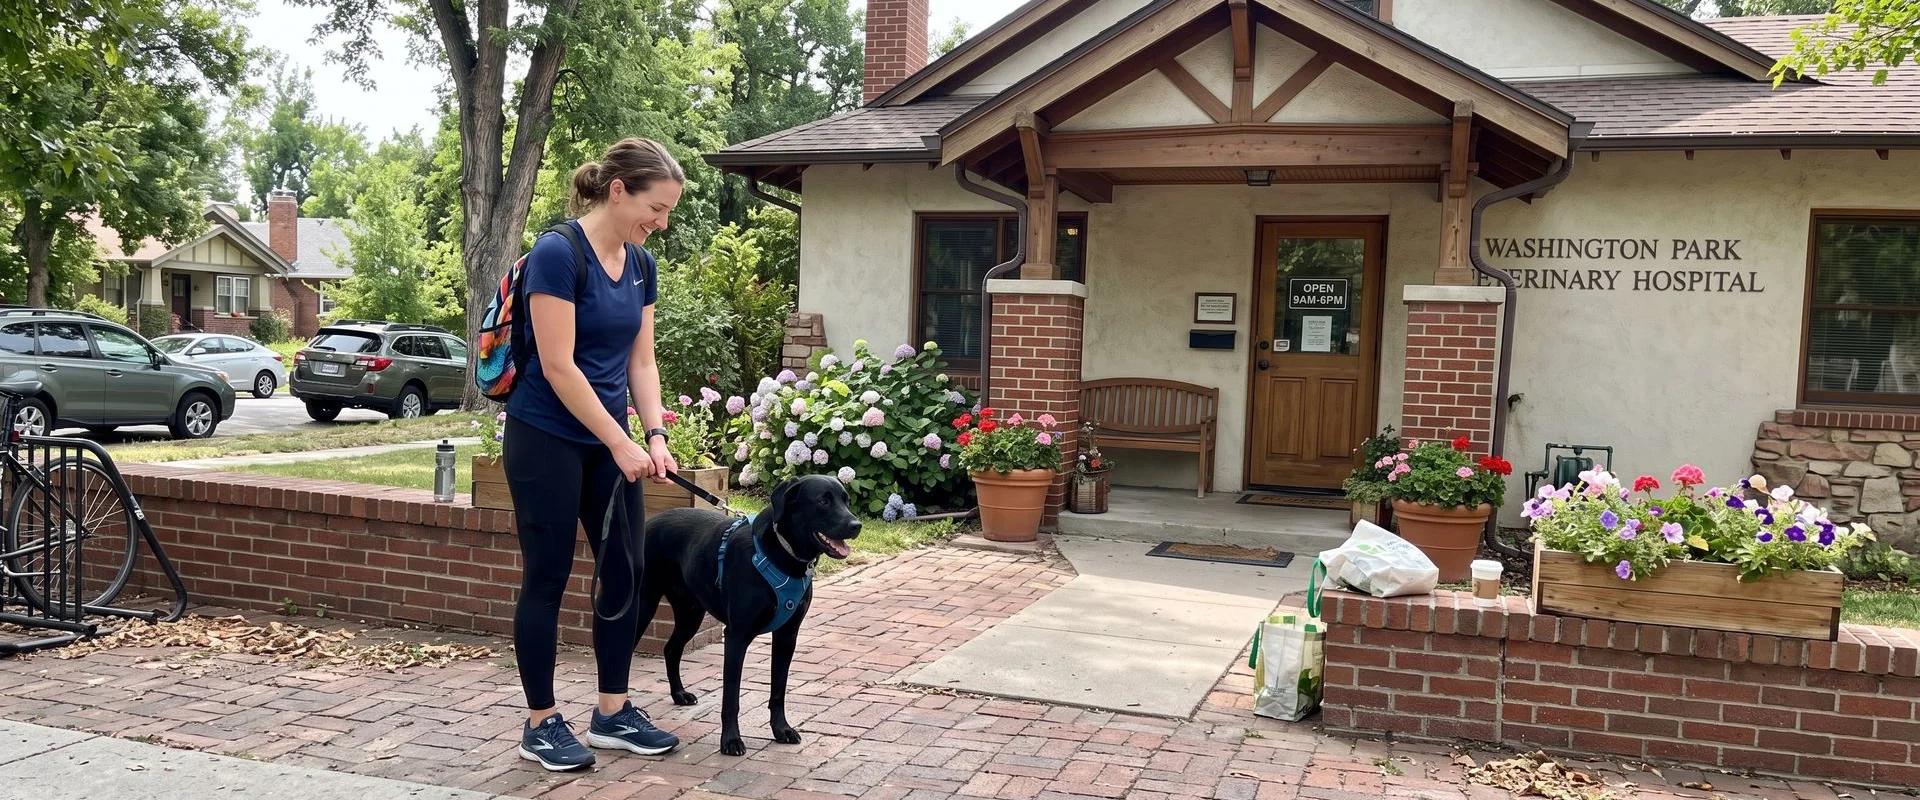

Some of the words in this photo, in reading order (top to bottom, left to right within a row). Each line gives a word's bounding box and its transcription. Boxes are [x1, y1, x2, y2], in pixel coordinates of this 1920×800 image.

[1485, 238, 1659, 259] WASHINGTON
[1671, 239, 1742, 260] PARK
[1303, 283, 1334, 293] OPEN
[1472, 268, 1621, 290] EERINARY
[1632, 270, 1765, 292] HOSPITAL
[1293, 295, 1343, 305] 9AM-6PM
